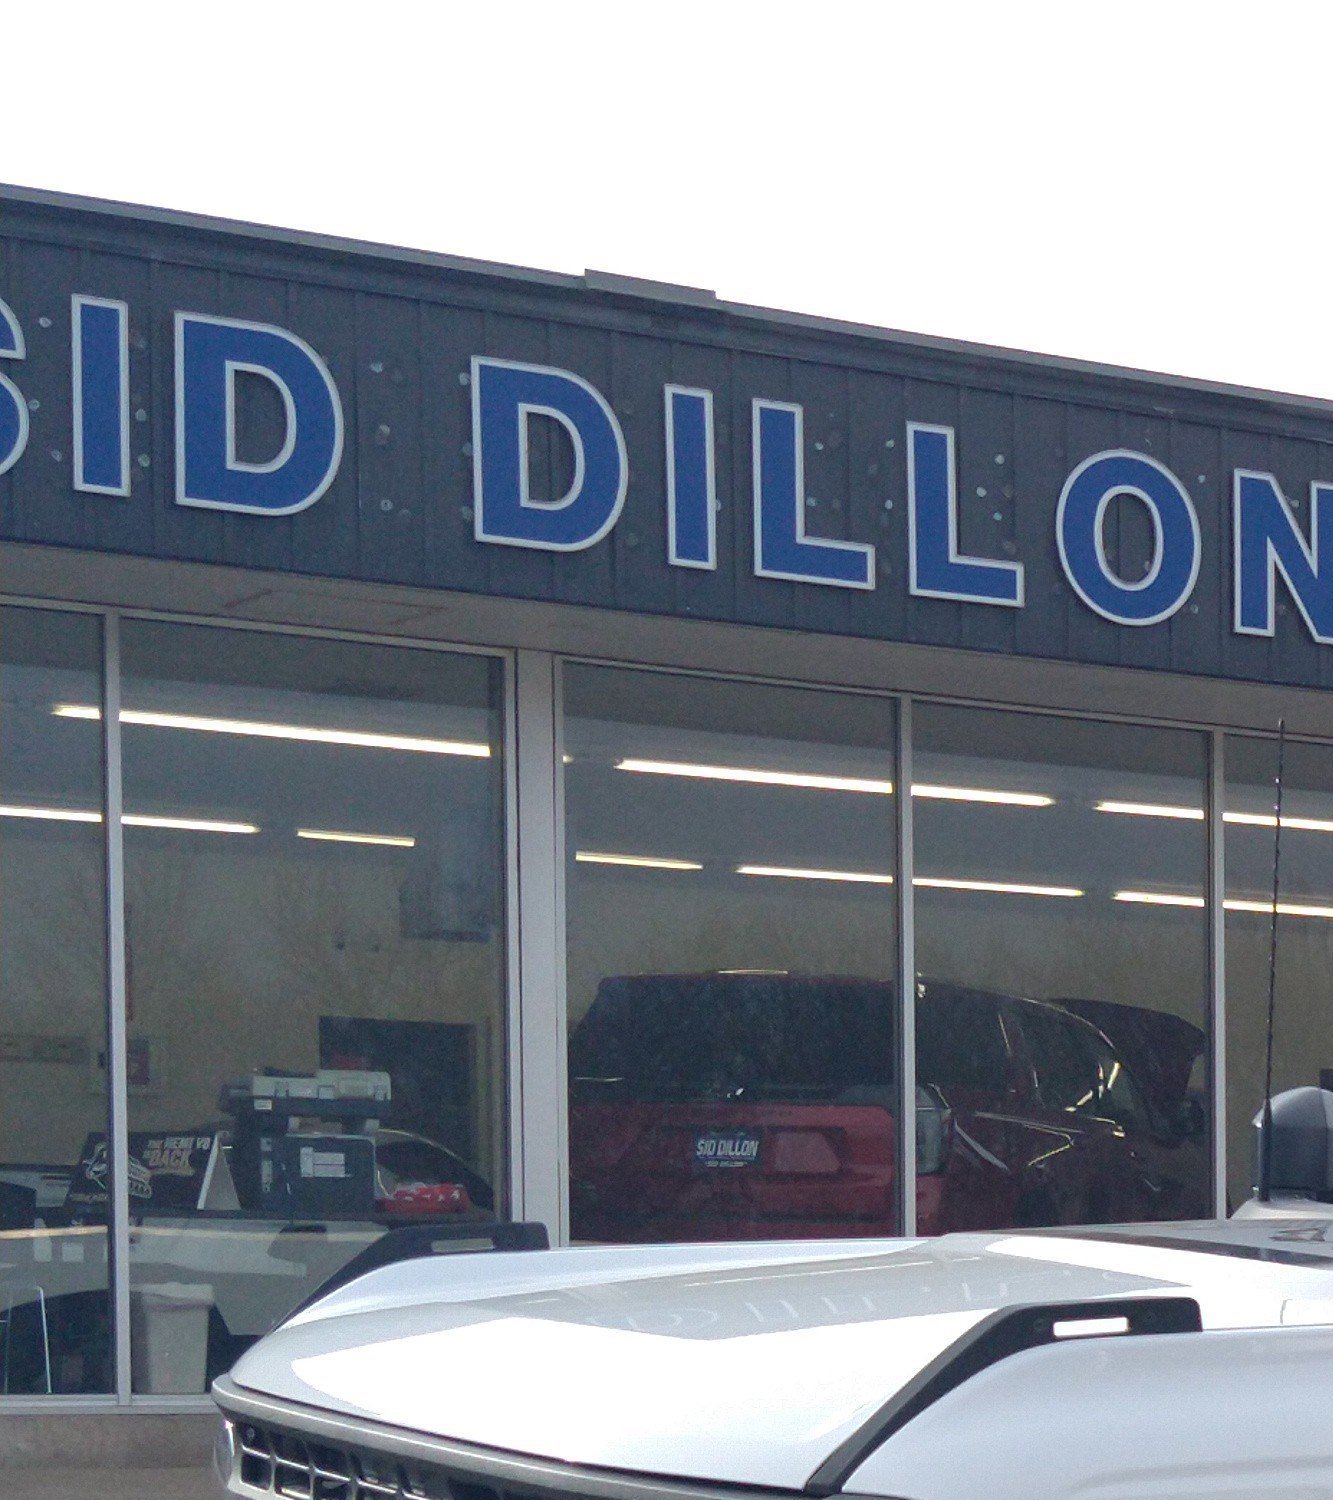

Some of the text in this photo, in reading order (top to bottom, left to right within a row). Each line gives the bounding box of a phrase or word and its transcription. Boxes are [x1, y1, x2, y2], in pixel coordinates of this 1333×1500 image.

[0, 293, 344, 517] ID
[697, 1139, 760, 1156] SID DILLON
